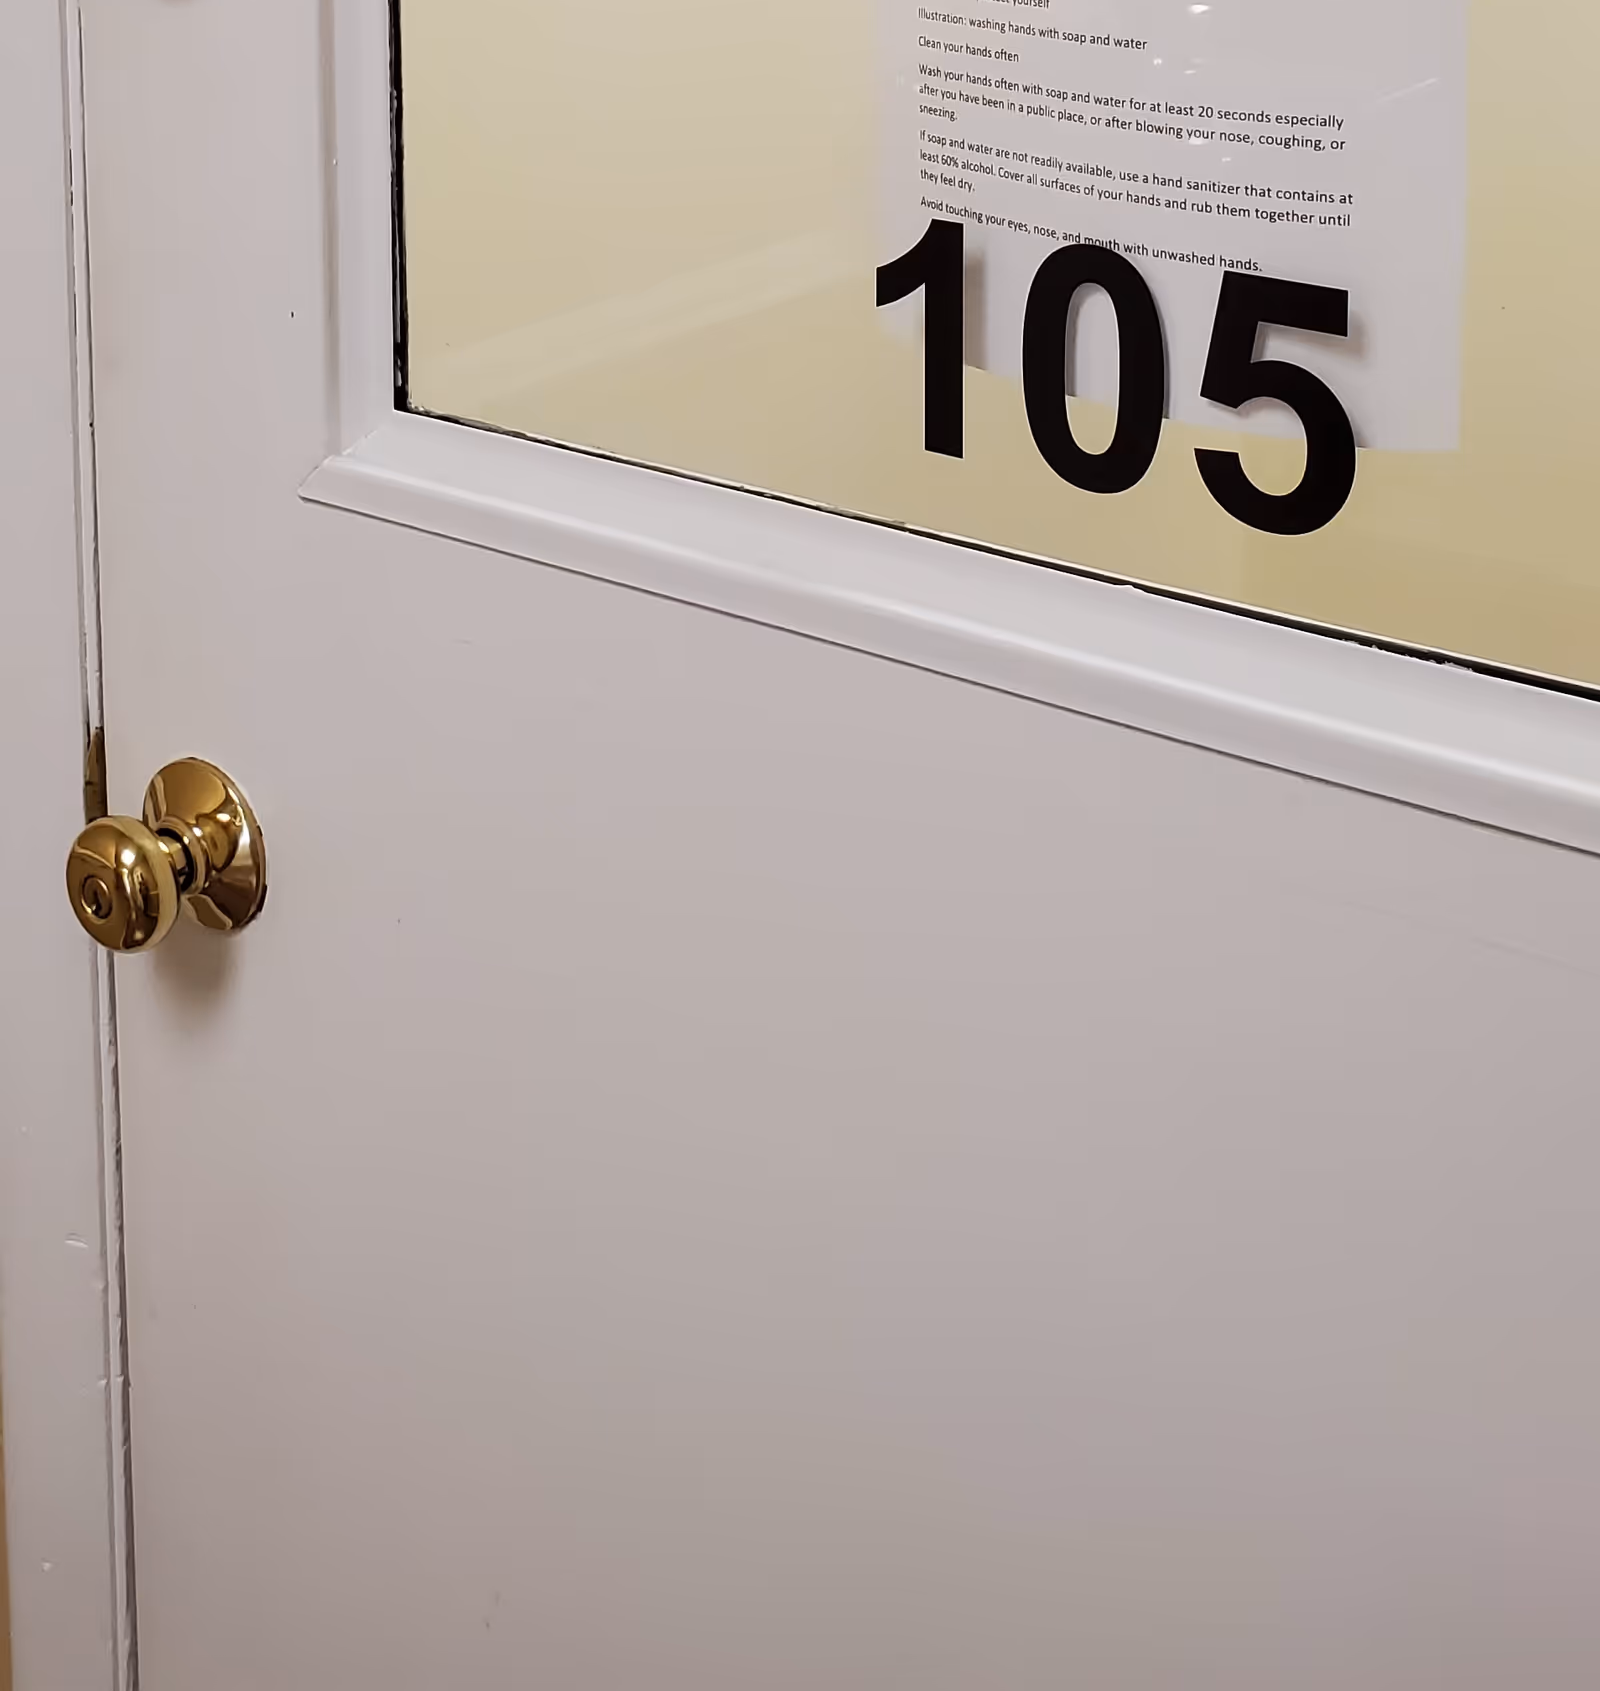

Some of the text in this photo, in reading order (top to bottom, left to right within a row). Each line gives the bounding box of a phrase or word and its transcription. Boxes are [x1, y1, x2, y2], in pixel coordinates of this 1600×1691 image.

[918, 7, 1148, 50] Illustration: washing hands with soap and water
[918, 36, 1019, 62] Clean your hands often
[920, 168, 975, 193] they feel dry.
[920, 196, 944, 212] Avoid
[944, 202, 984, 224] touching
[984, 214, 1006, 226] your
[1007, 220, 1031, 235] eyes,
[1033, 226, 1060, 241] nose,
[1062, 232, 1081, 244] and
[1123, 242, 1149, 257] with
[1152, 248, 1215, 266] unwashed
[1219, 254, 1263, 272] hands.
[876, 218, 1356, 535] 105
